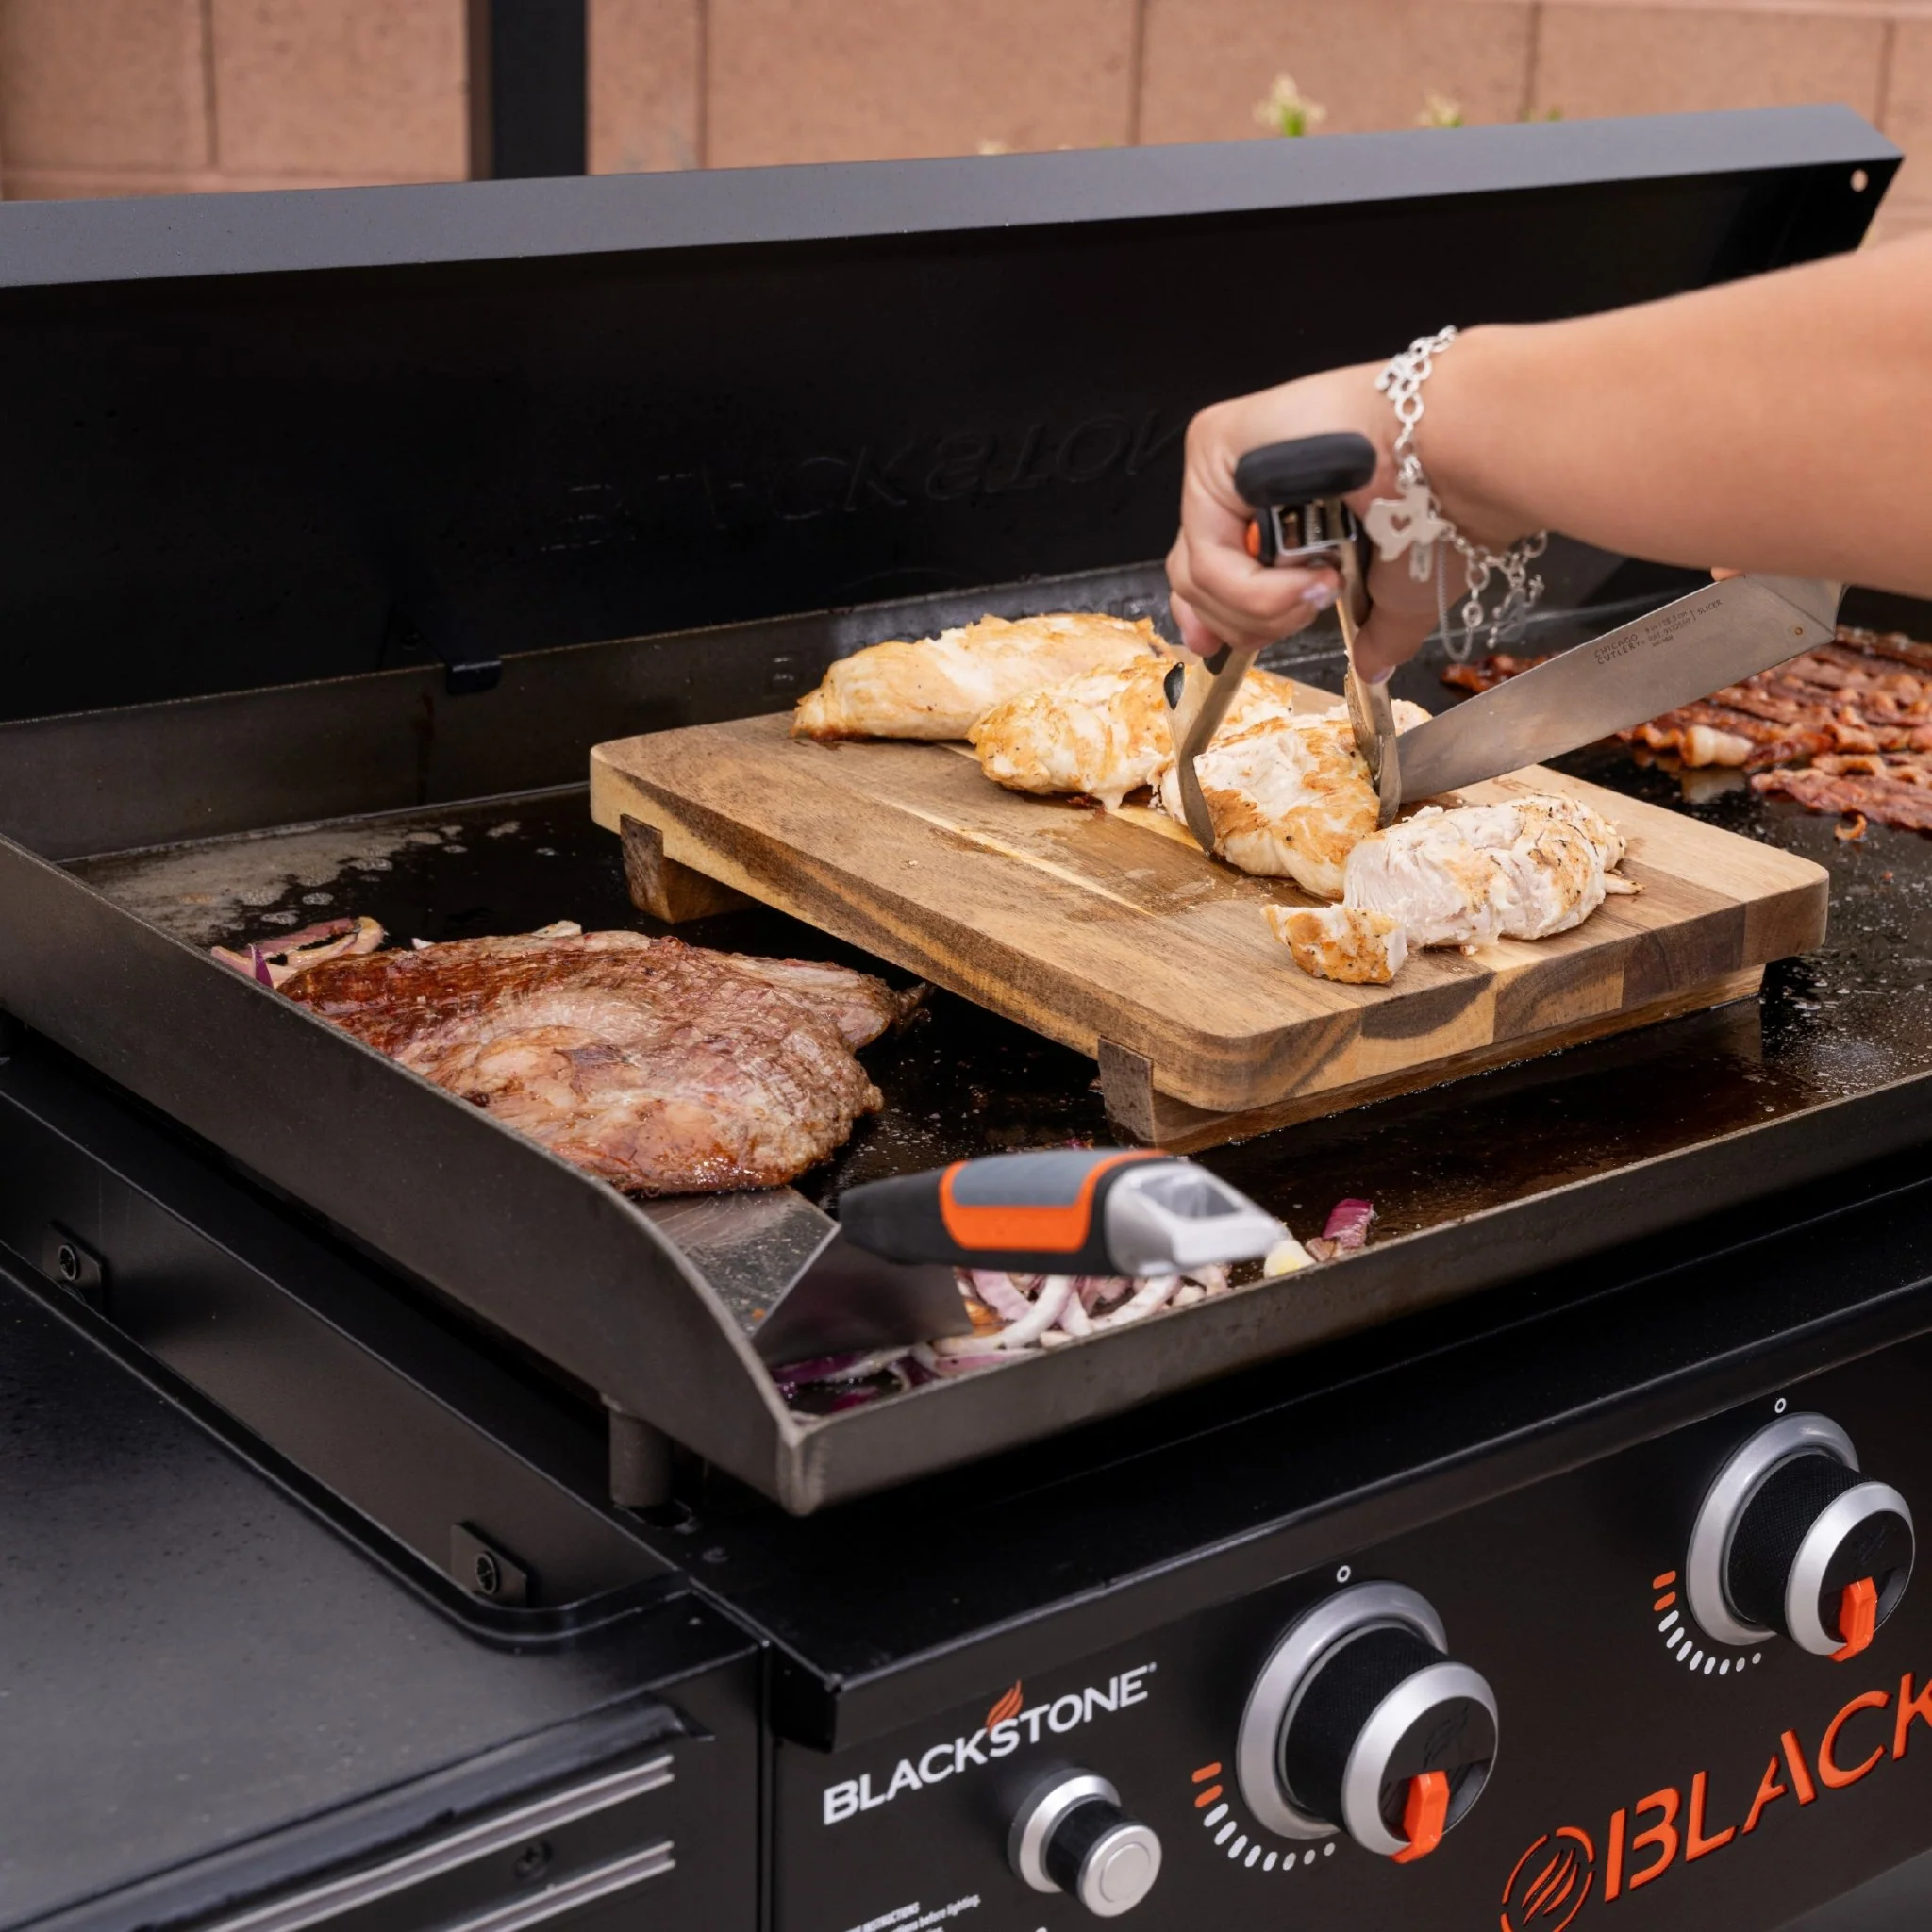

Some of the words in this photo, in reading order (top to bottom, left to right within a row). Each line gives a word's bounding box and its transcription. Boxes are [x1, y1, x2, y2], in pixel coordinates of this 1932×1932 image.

[1594, 633, 1638, 658] CHICAGO
[824, 1664, 1149, 1825] BLACKSTONE
[1604, 1671, 1932, 1904] BLACK
